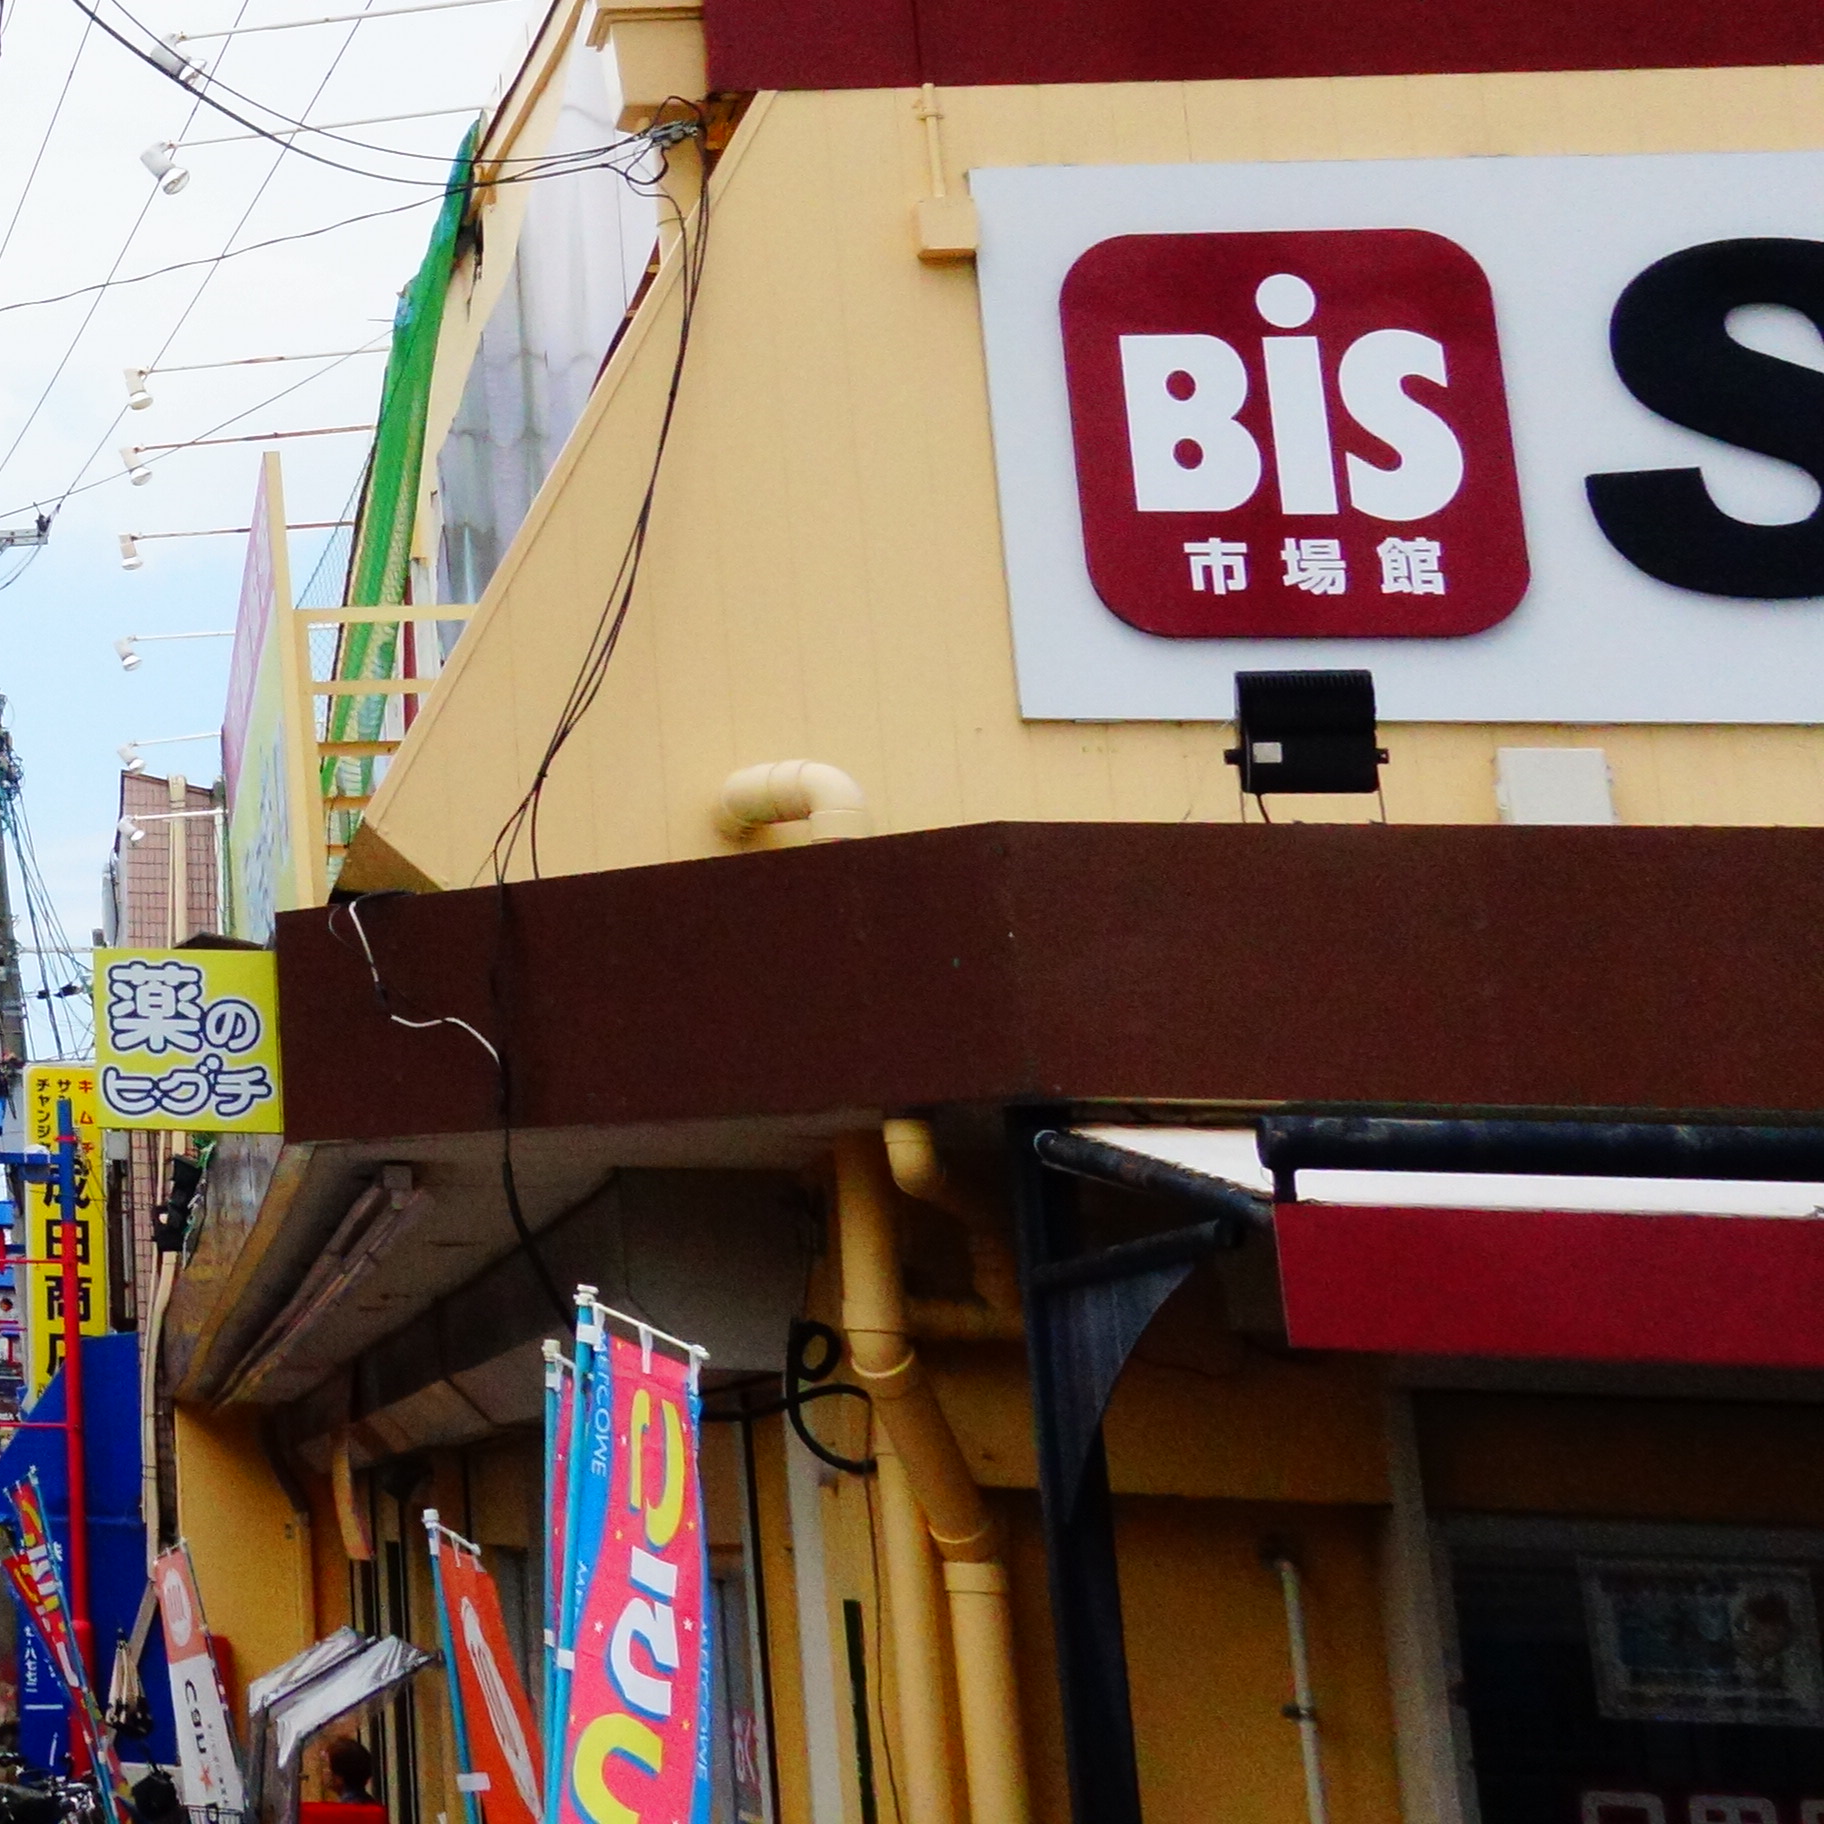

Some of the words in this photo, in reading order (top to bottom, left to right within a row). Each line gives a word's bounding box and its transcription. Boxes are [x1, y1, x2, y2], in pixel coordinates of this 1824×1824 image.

[1184, 536, 1446, 597] 市場館
[107, 960, 261, 1054] 薬の
[77, 1079, 94, 1154] キムチ
[102, 1052, 273, 1117] ヒグチ
